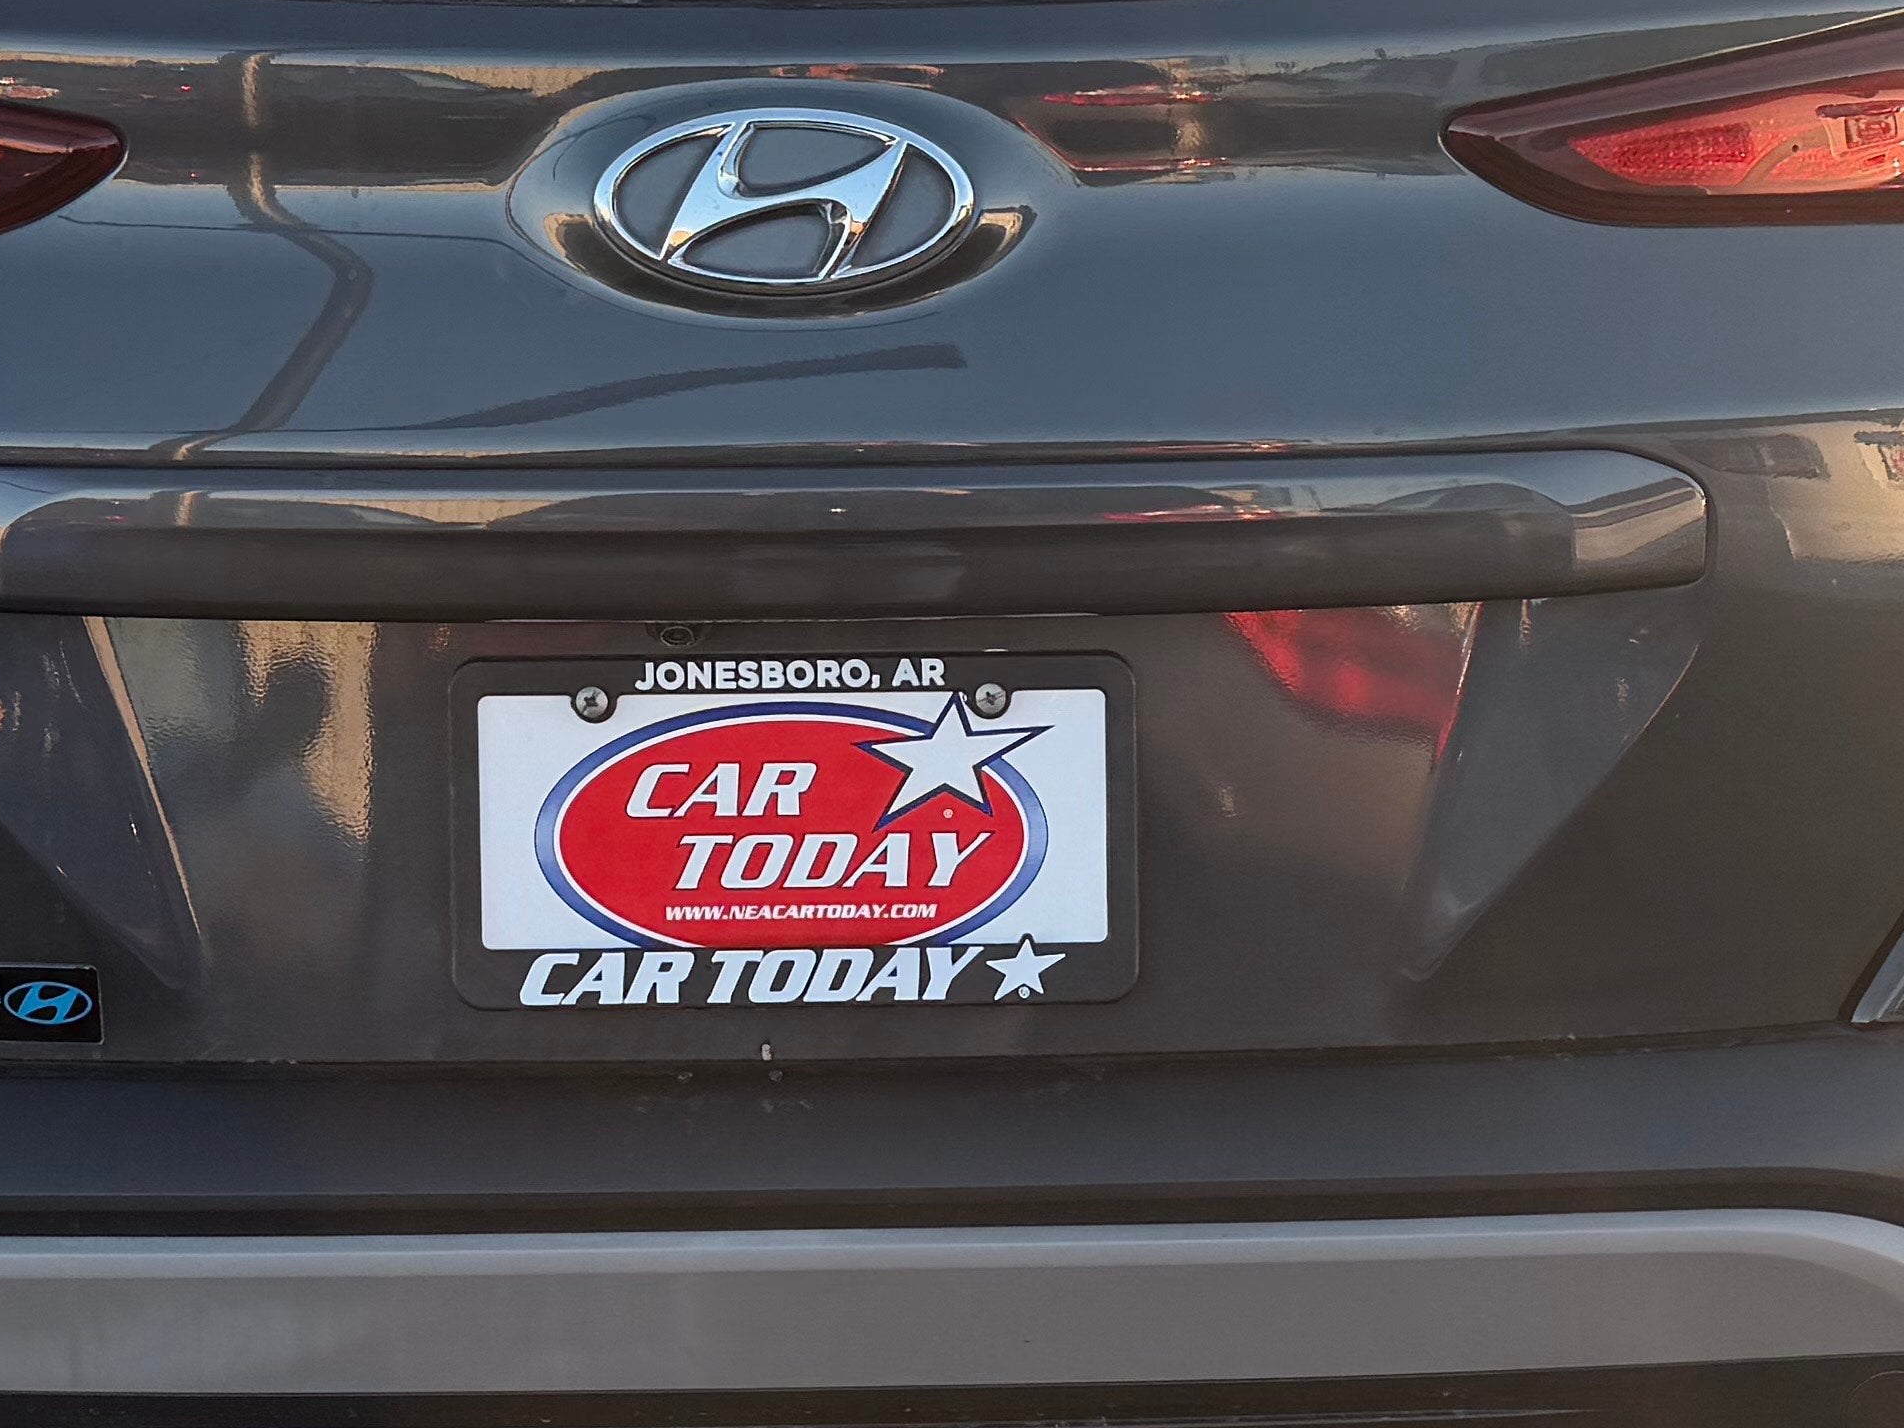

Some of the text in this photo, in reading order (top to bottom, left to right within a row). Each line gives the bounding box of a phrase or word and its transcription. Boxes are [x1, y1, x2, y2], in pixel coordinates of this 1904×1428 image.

[634, 658, 946, 690] JONESBORO, AR
[626, 762, 818, 818] CAR
[673, 832, 995, 889] TODAY
[665, 903, 938, 921] WWW.NEACARTODAY.COM
[519, 946, 984, 1006] CAR TODAY
